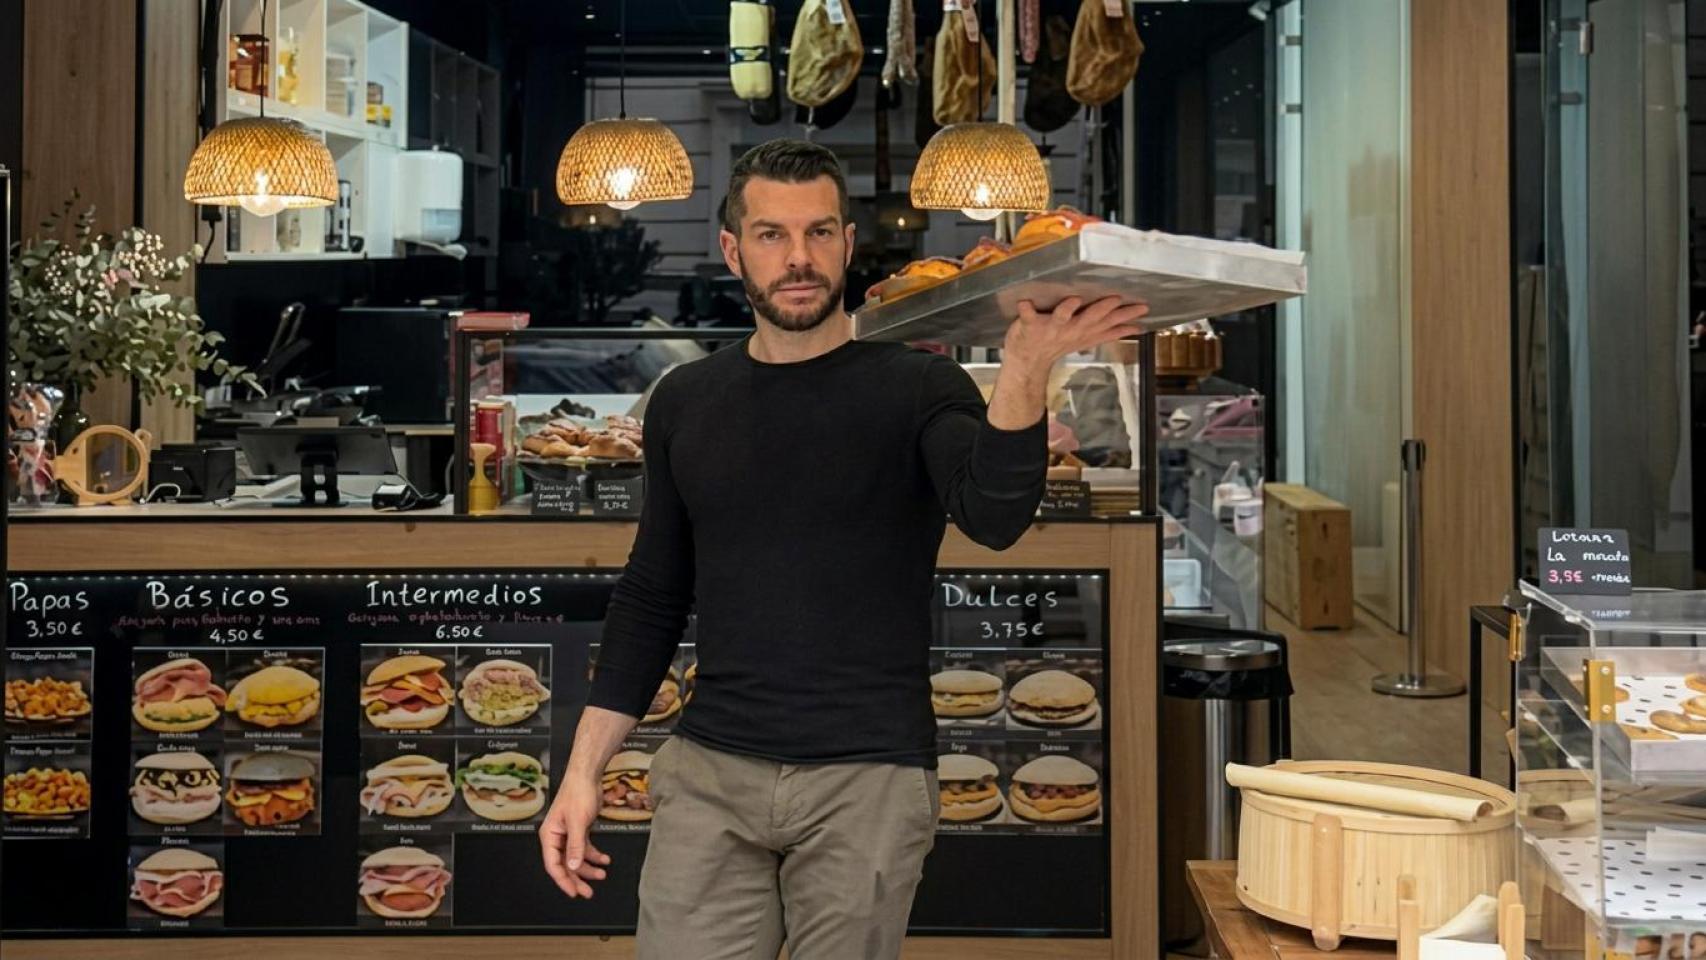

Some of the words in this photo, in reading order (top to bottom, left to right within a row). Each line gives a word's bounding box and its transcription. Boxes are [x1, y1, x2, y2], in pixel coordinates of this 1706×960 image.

[1547, 547, 1566, 562] La
[10, 582, 89, 618] Papas
[146, 581, 290, 609] Básicos
[366, 580, 542, 607] Intermedios
[941, 583, 1058, 607] Dulces
